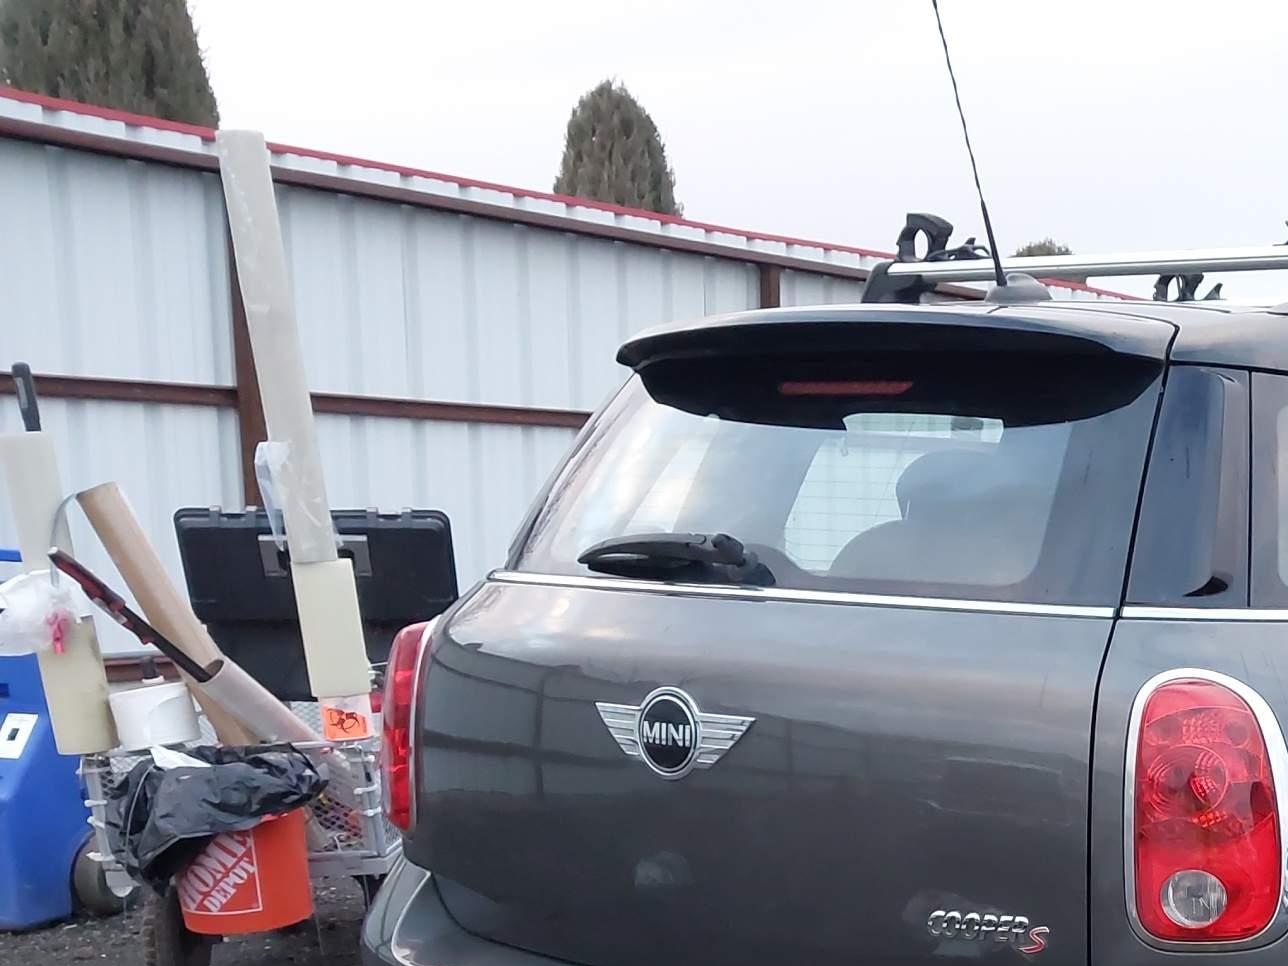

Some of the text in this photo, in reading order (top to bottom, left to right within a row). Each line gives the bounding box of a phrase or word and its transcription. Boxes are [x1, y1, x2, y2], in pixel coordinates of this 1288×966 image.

[643, 720, 692, 748] MINI
[203, 857, 256, 913] DEPOT
[927, 910, 1050, 954] COOPER S
